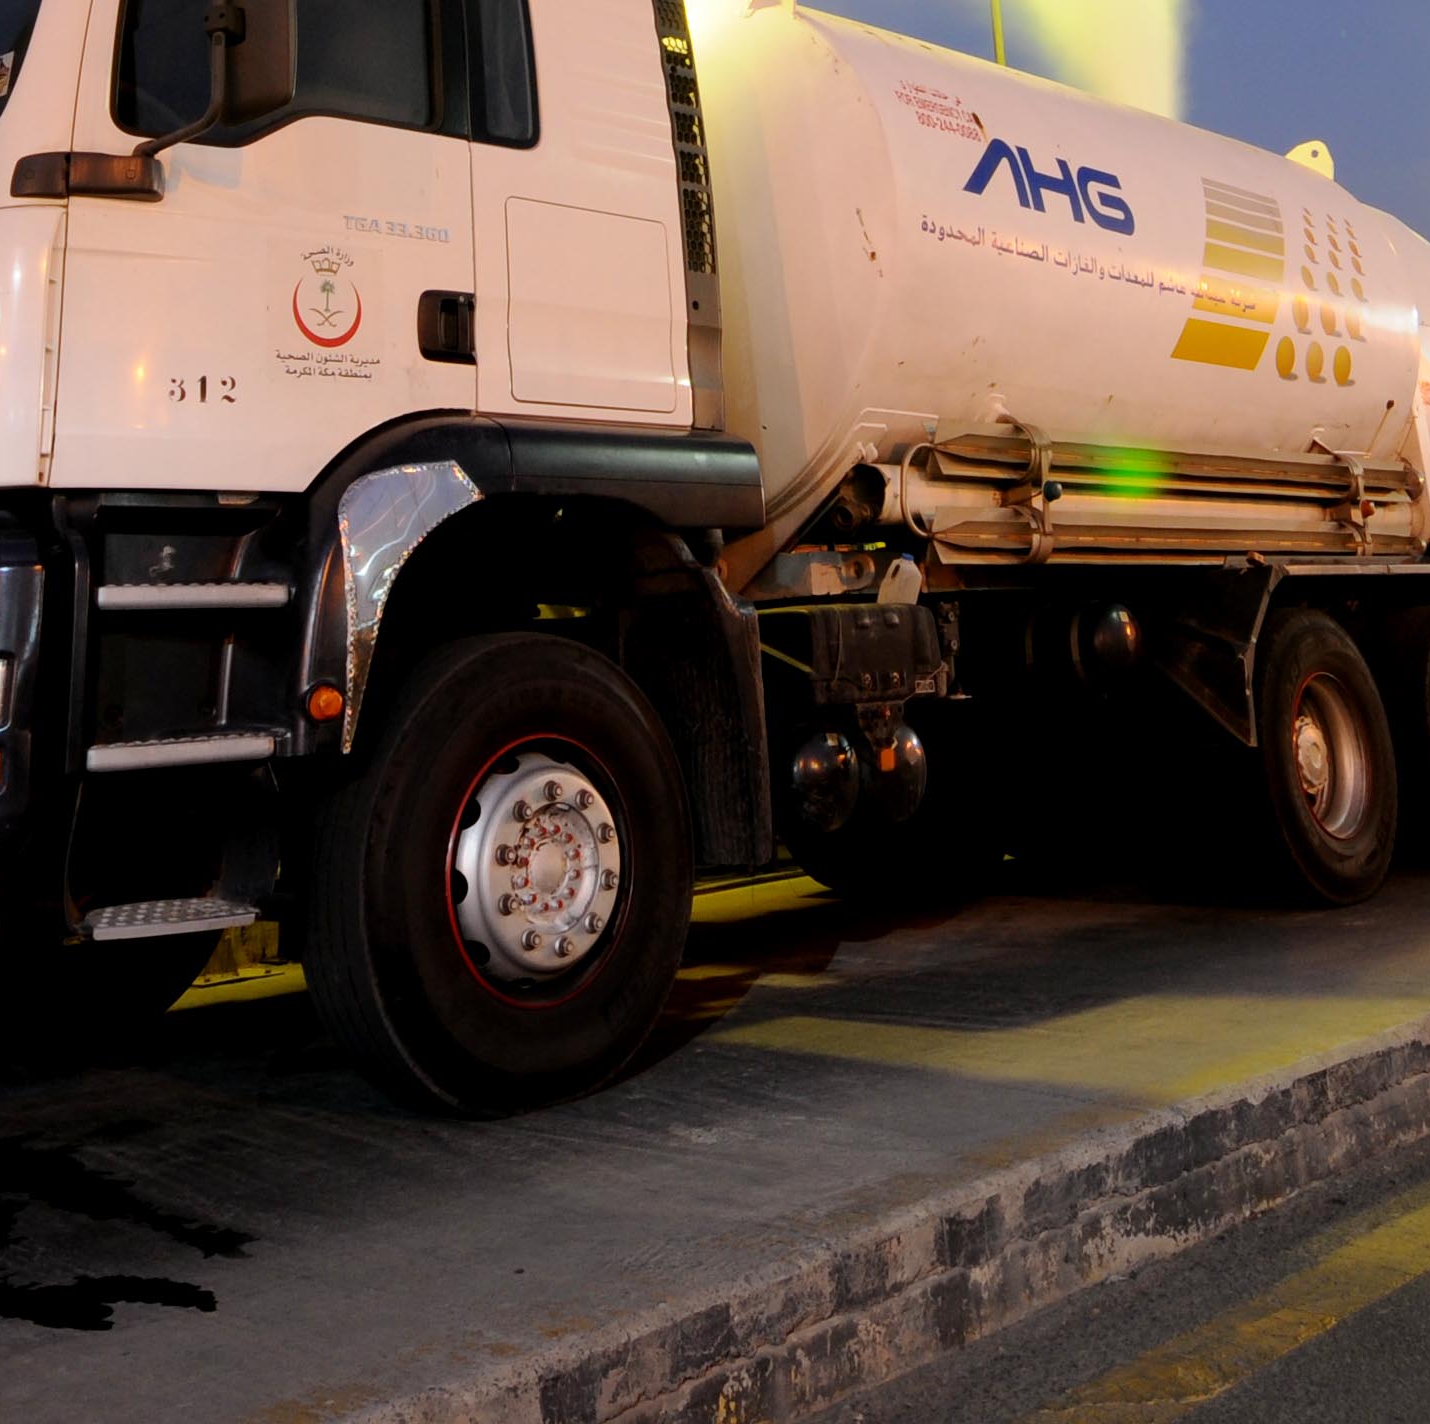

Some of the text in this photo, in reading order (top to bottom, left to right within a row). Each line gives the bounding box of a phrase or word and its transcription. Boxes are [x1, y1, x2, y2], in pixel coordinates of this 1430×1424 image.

[962, 138, 1136, 236] AHG
[921, 214, 986, 247] المحدودة
[990, 231, 1049, 263] الصناعية
